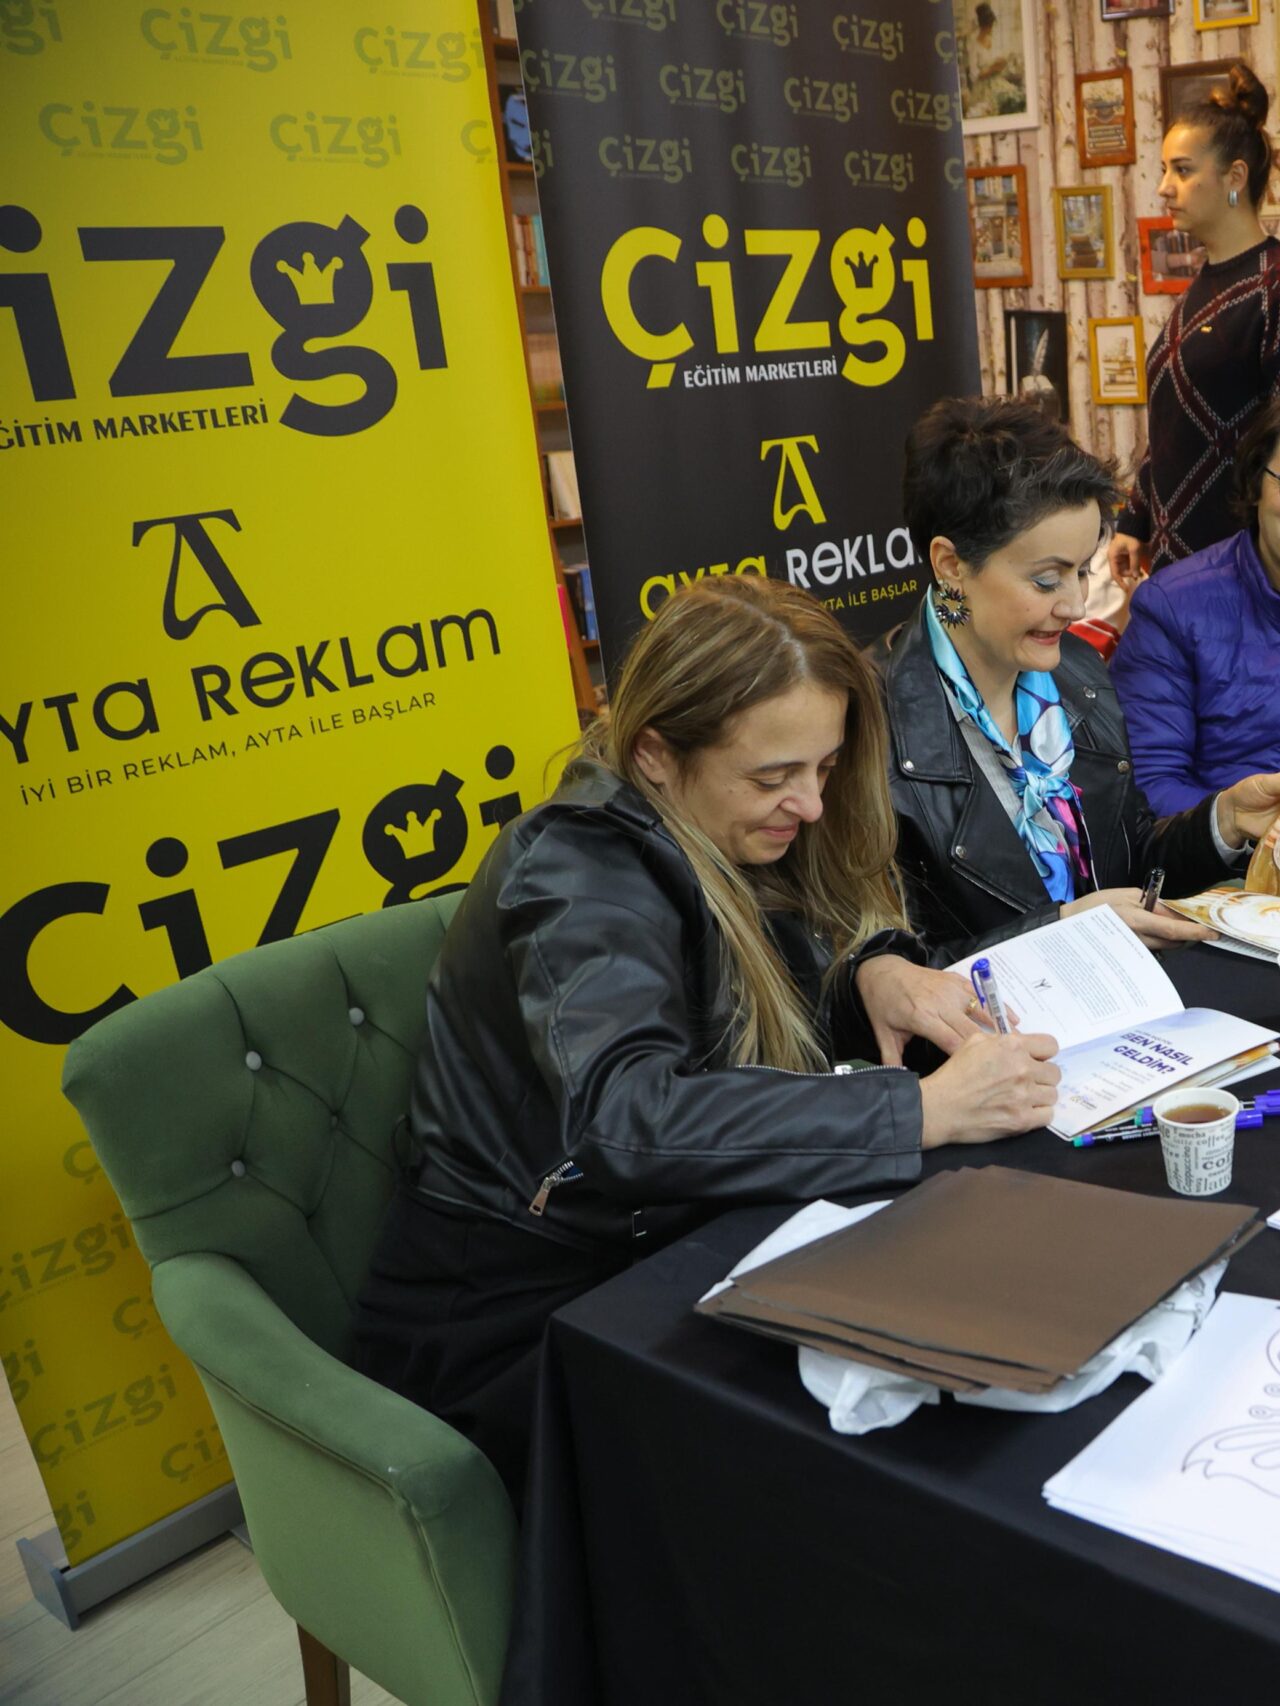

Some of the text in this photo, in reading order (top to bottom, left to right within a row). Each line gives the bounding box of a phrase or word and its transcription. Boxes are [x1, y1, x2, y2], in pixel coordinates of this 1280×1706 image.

[140, 8, 292, 72] Çizgi
[832, 14, 904, 61] Çizgi
[659, 64, 746, 112] Çizgi
[783, 77, 858, 122] Çizgi
[38, 101, 205, 165] Çizgi
[268, 112, 402, 168] Çizgi
[599, 137, 693, 183] Çizgi
[731, 143, 812, 187] Çizgi
[844, 151, 914, 192] Çizgi
[0, 203, 448, 437] izgi
[601, 213, 934, 390] Çizgi
[683, 354, 838, 388] EĞİTİM MARKETLERİ
[0, 398, 269, 450] ĞİTİM MARKETLERİ
[848, 579, 918, 608] İLE BAŞLAR
[20, 692, 437, 806] İYİ BİR REKLAM, AYTA İLE BAŞLAR
[1113, 1045, 1177, 1074] GELDİM?
[1120, 1032, 1194, 1066] BEN NASIL
